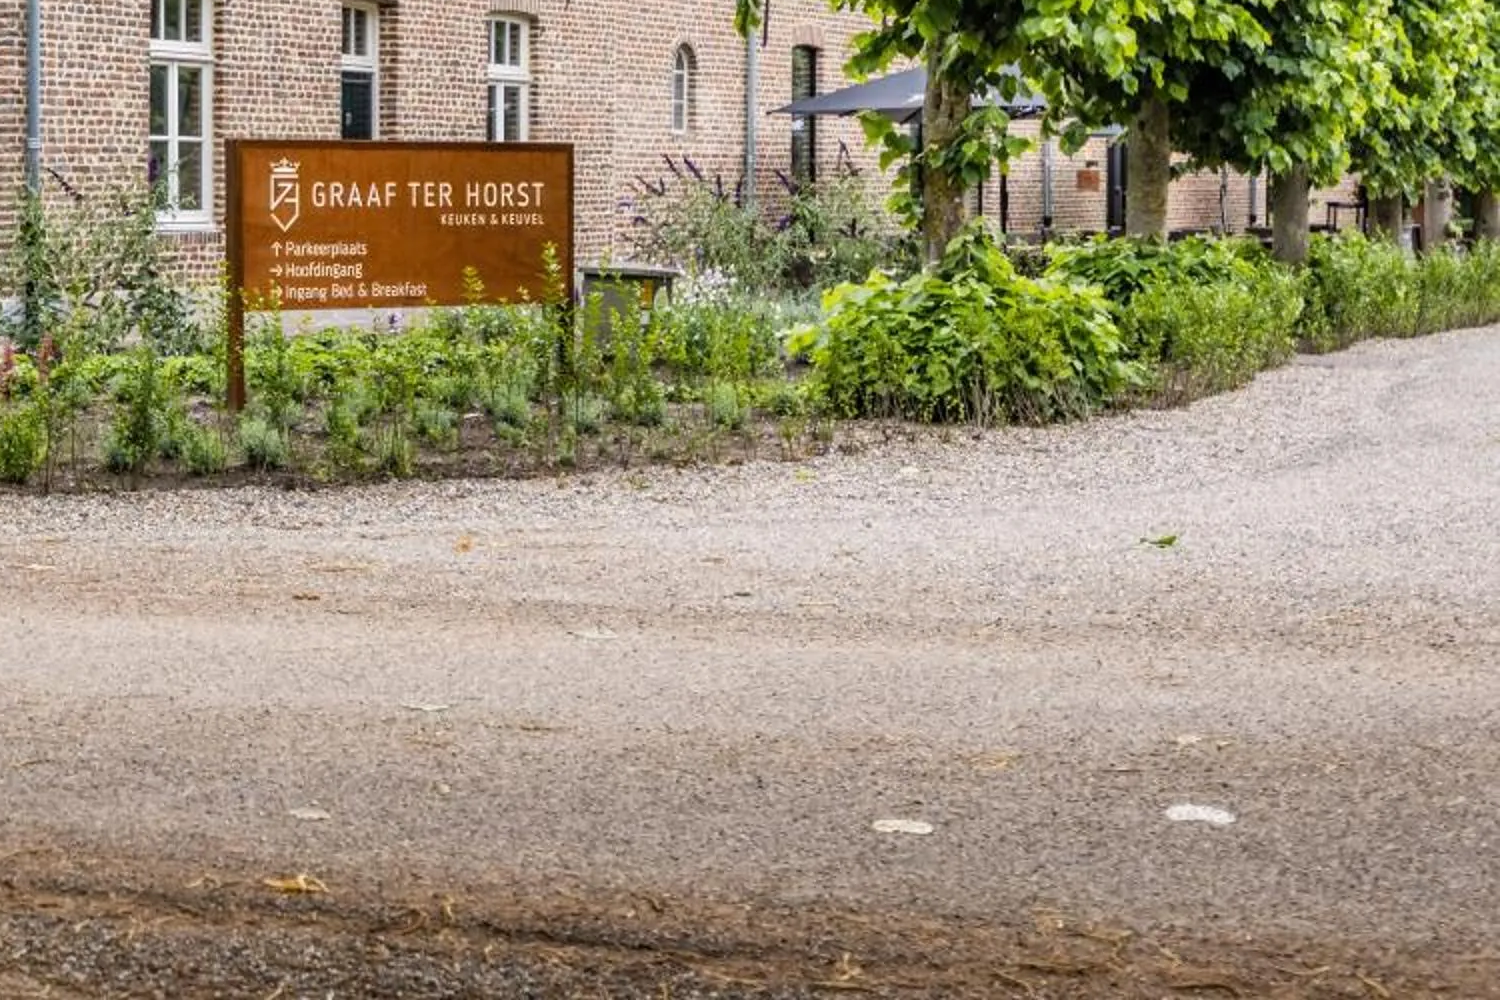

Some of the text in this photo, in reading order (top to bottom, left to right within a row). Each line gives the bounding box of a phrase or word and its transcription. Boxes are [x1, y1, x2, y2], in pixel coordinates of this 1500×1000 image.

[311, 181, 545, 208] GRAAF TER HORST
[440, 213, 545, 226] KEUKEN & KEUVEL
[285, 241, 368, 258] Parkeerplaats
[285, 261, 363, 278] Hoofdingang
[286, 281, 428, 301] Ingang Bed & Breakfast
